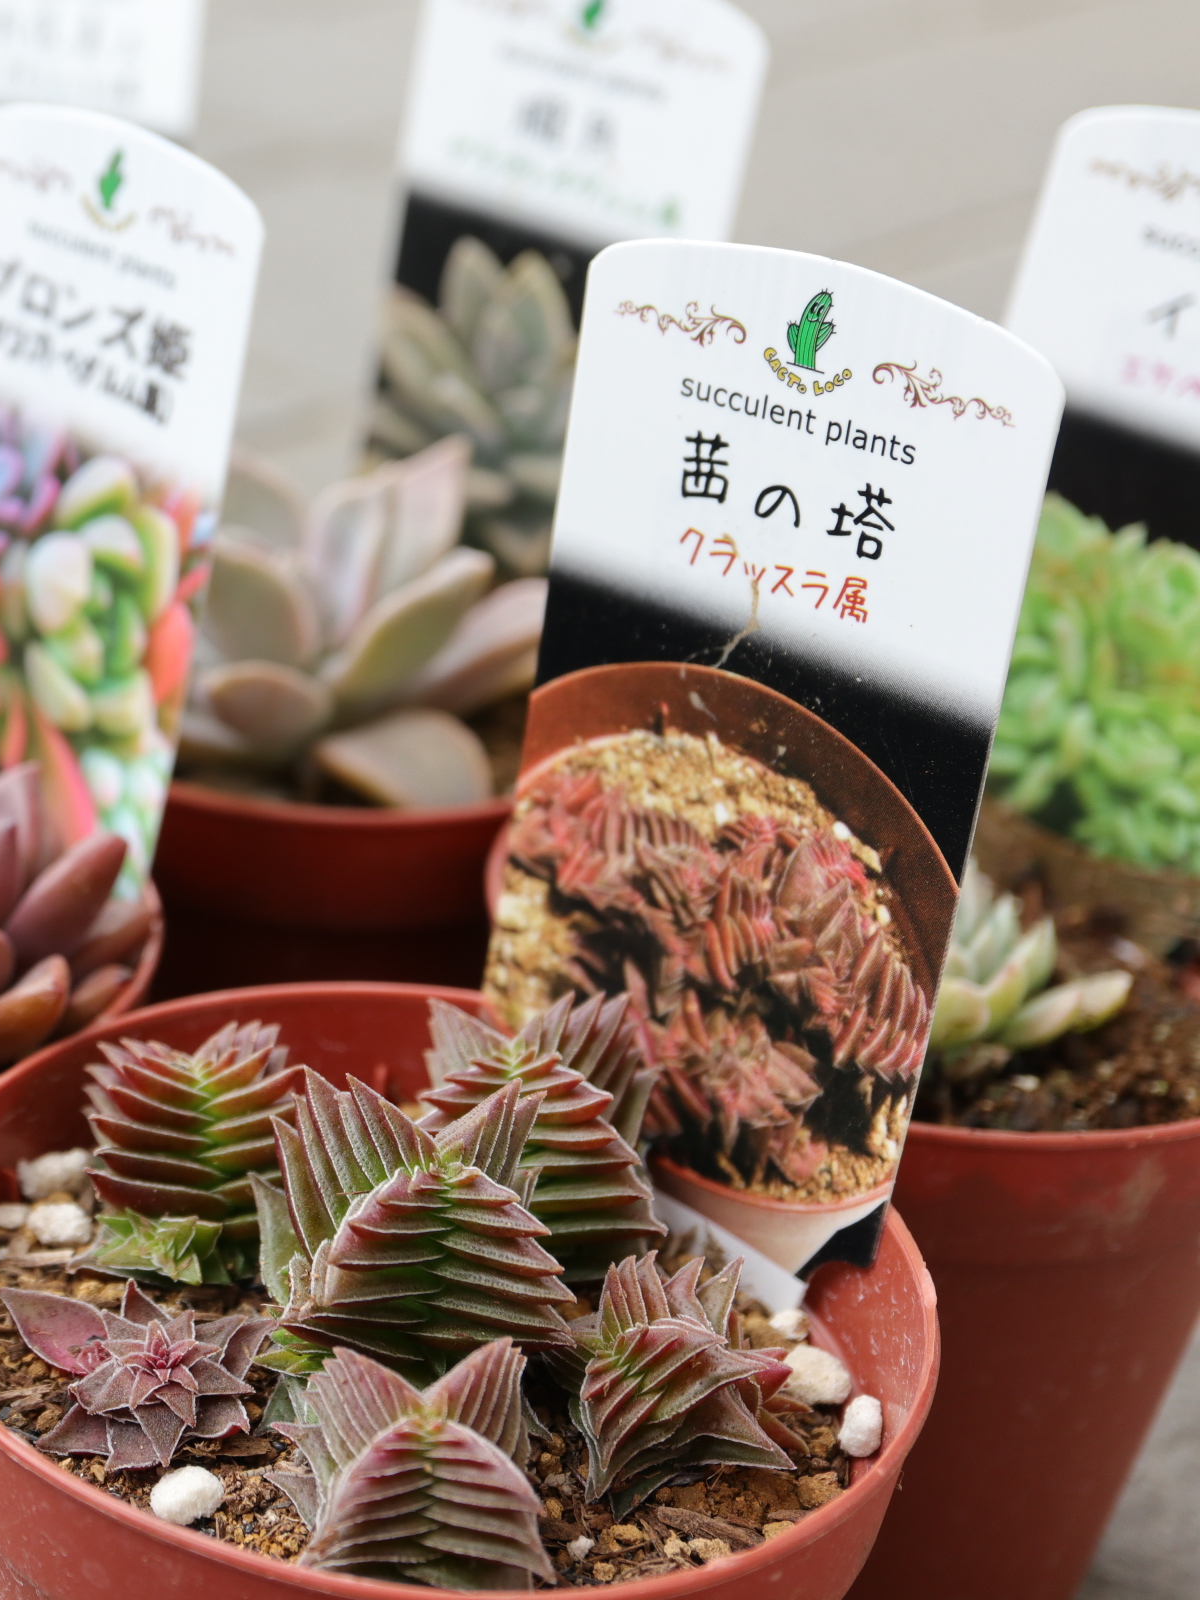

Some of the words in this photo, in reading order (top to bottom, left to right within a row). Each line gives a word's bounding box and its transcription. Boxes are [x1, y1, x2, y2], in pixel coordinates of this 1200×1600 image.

[763, 347, 807, 394] CACTO
[813, 368, 853, 396] LOCO
[680, 377, 817, 435] succulent
[825, 419, 917, 466] plants
[681, 429, 896, 561] 茜の塔
[680, 527, 870, 624] クラッスラ属
